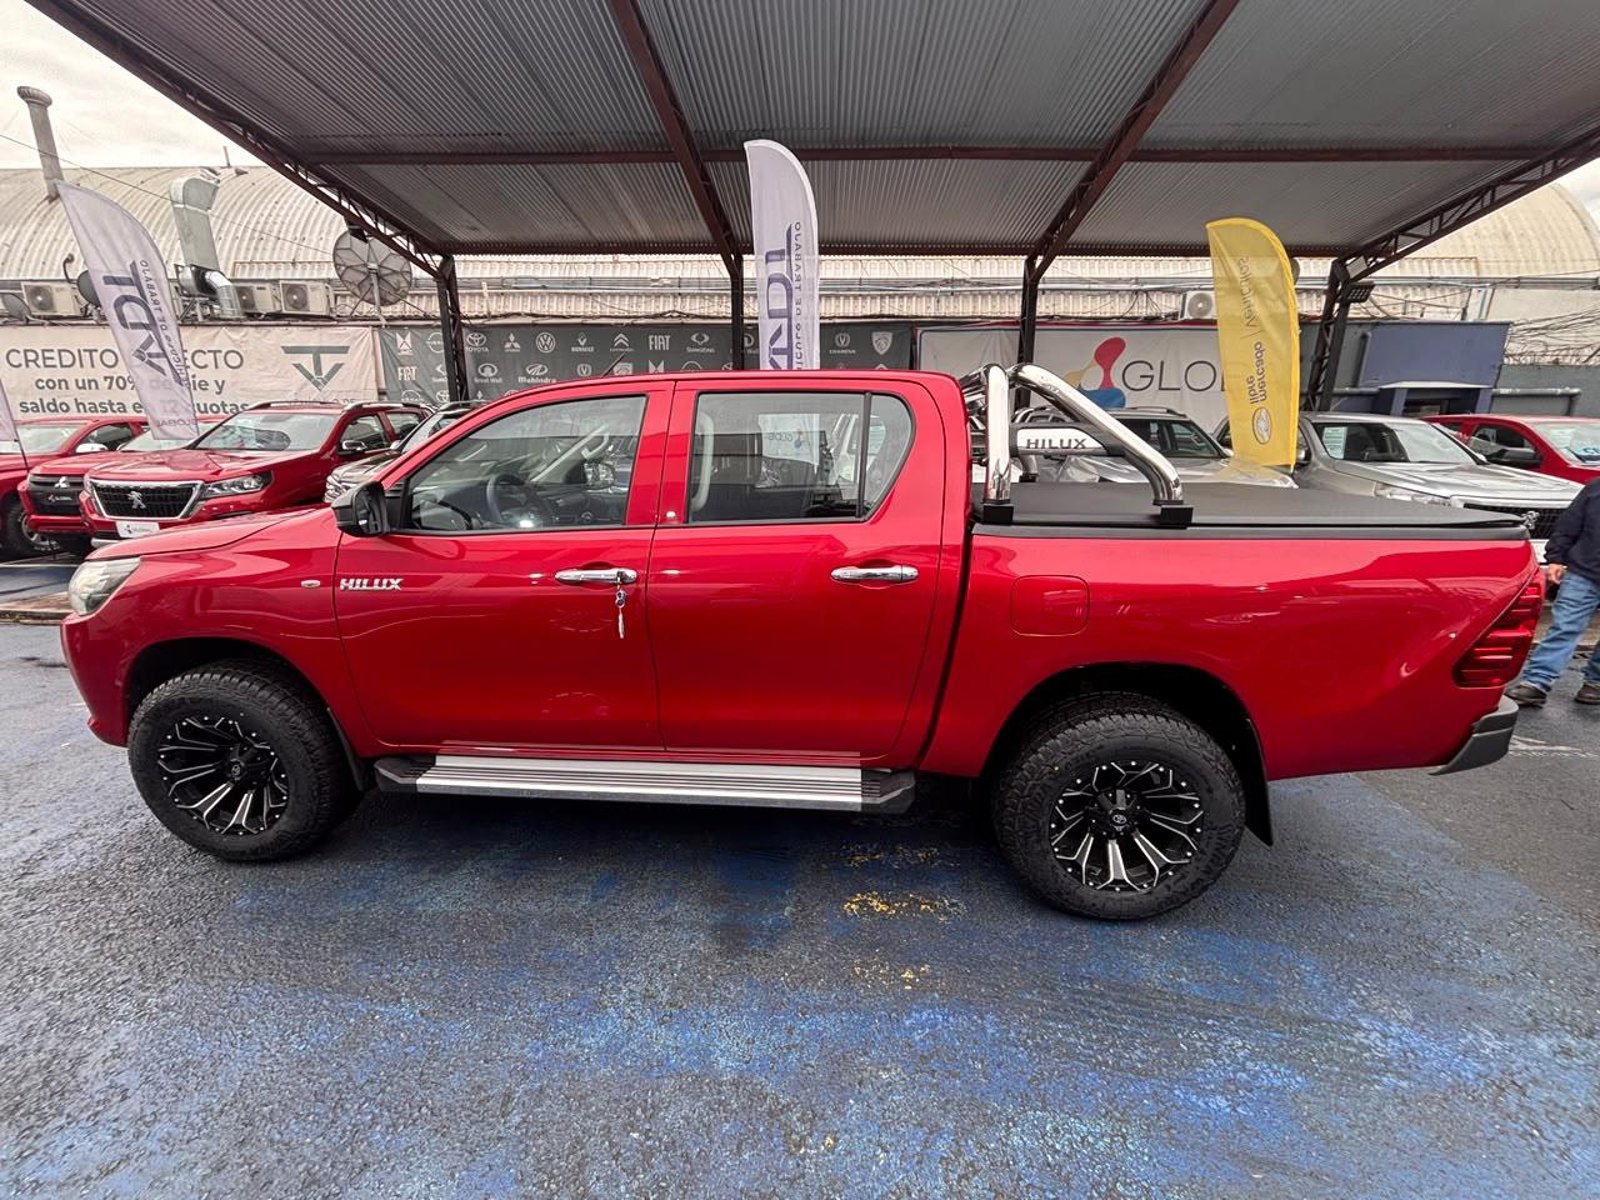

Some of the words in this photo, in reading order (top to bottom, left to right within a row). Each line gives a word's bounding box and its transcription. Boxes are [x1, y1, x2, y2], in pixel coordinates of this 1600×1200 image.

[648, 335, 671, 351] FIAT
[5, 348, 119, 369] CREDITO
[184, 348, 245, 370] CTO
[398, 366, 417, 381] FIAT
[35, 378, 70, 391] con
[75, 378, 100, 391] un
[213, 379, 227, 396] y
[19, 398, 70, 413] saldo
[74, 398, 127, 413] hasta
[132, 402, 145, 414] e
[196, 400, 250, 415] uotas
[1026, 438, 1088, 450] HILUX
[340, 578, 404, 591] HILUX
